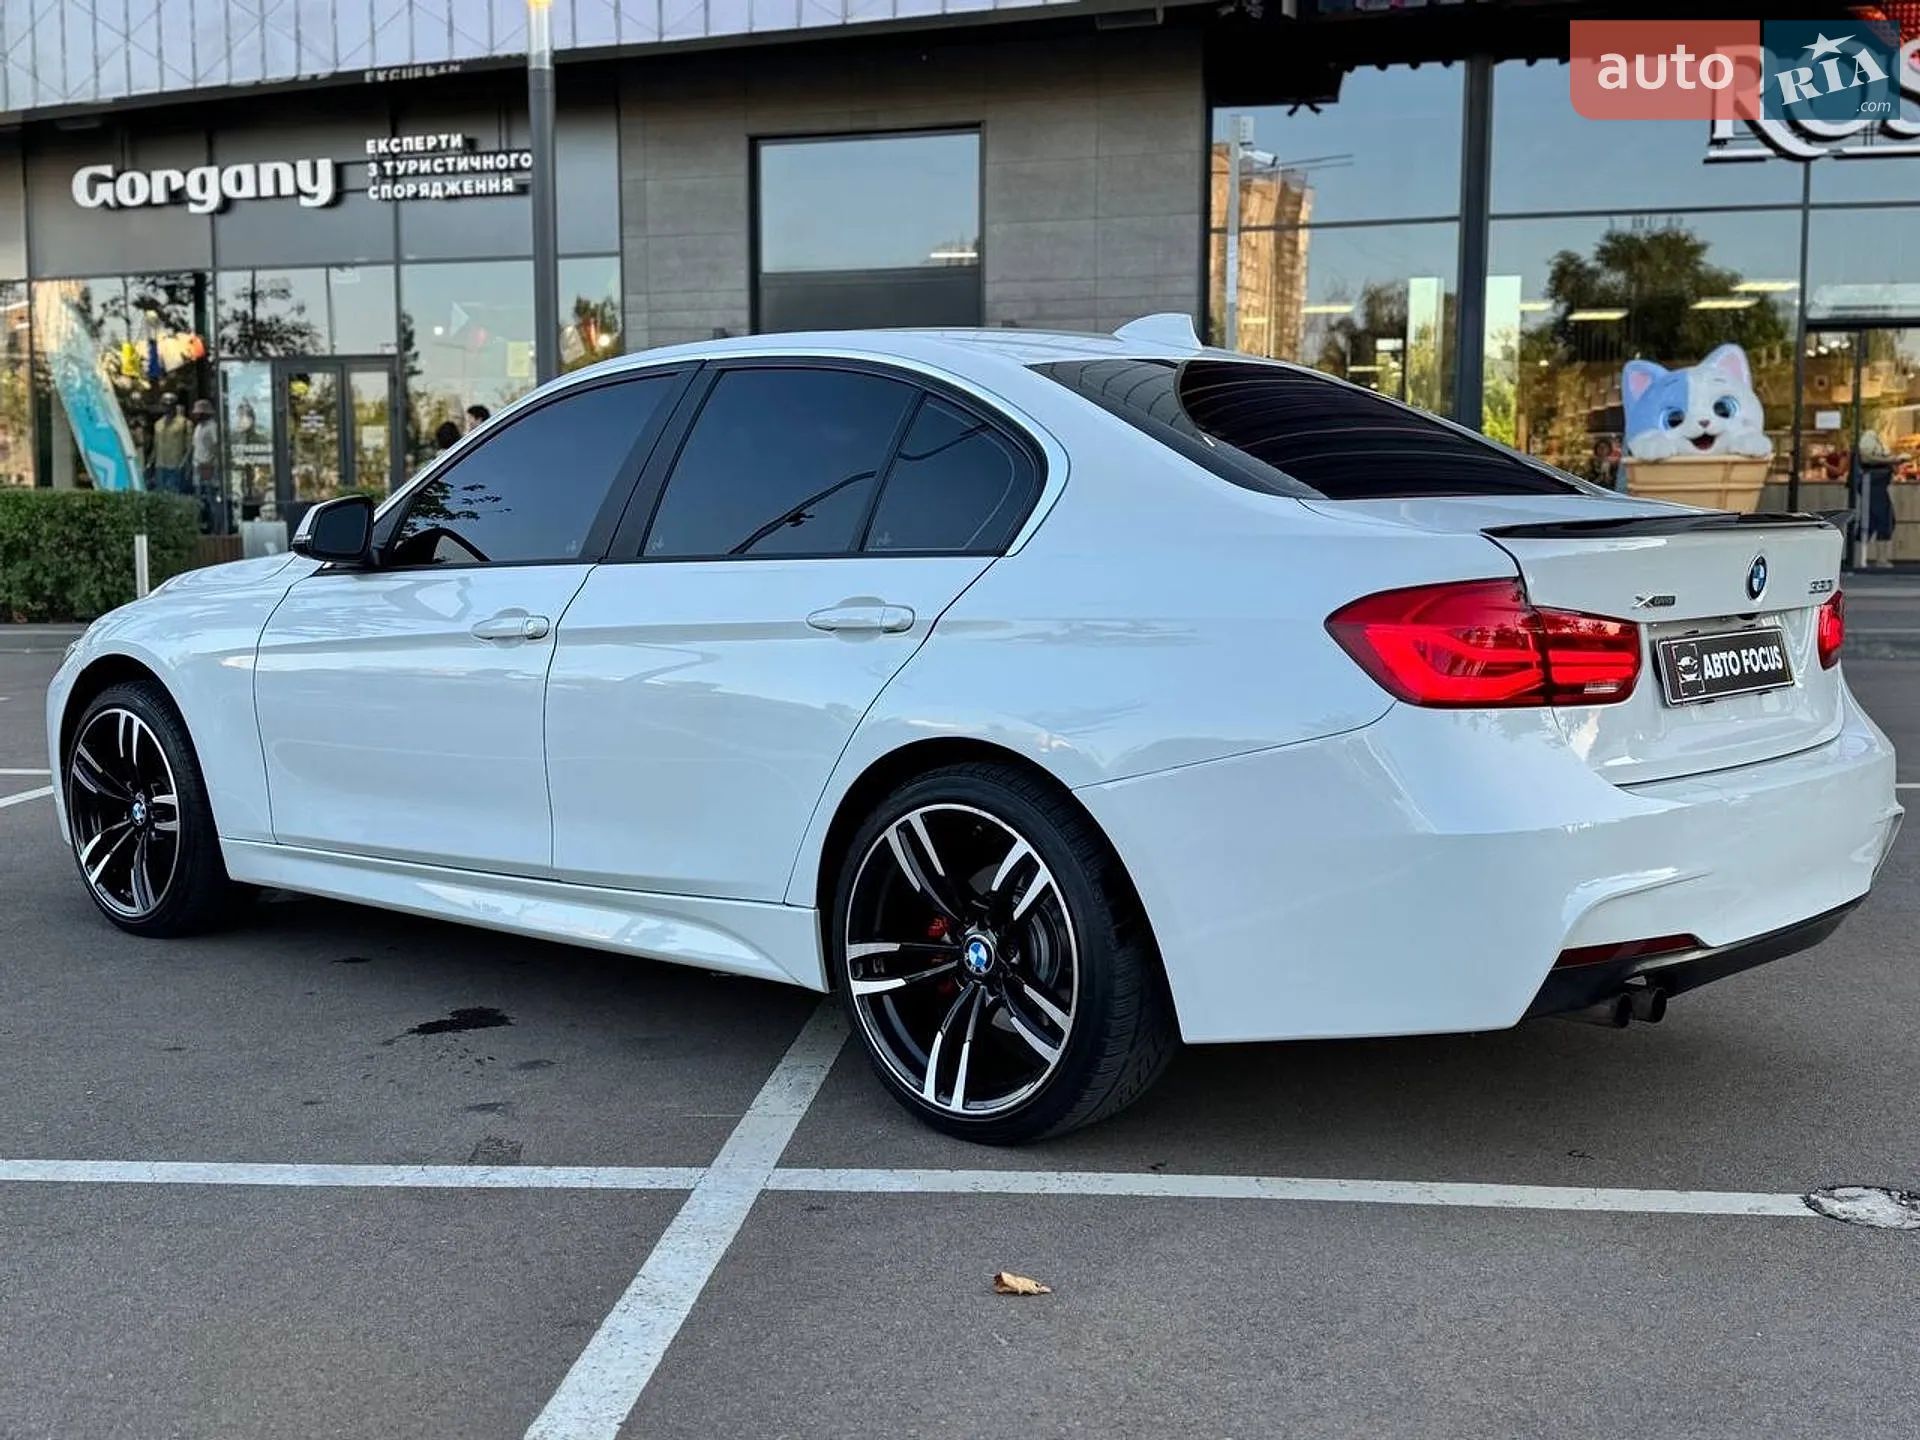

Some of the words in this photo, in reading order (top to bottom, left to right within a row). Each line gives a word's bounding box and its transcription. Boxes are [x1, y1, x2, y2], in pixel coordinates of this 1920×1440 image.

[366, 133, 463, 154] ЕКСПЕРТИ
[383, 153, 533, 175] ТУРИСТИЧНОГО
[72, 158, 333, 213] Gorgany
[368, 178, 514, 200] СПОРЯДЖЕННЯ
[1740, 645, 1783, 674] FOCUS
